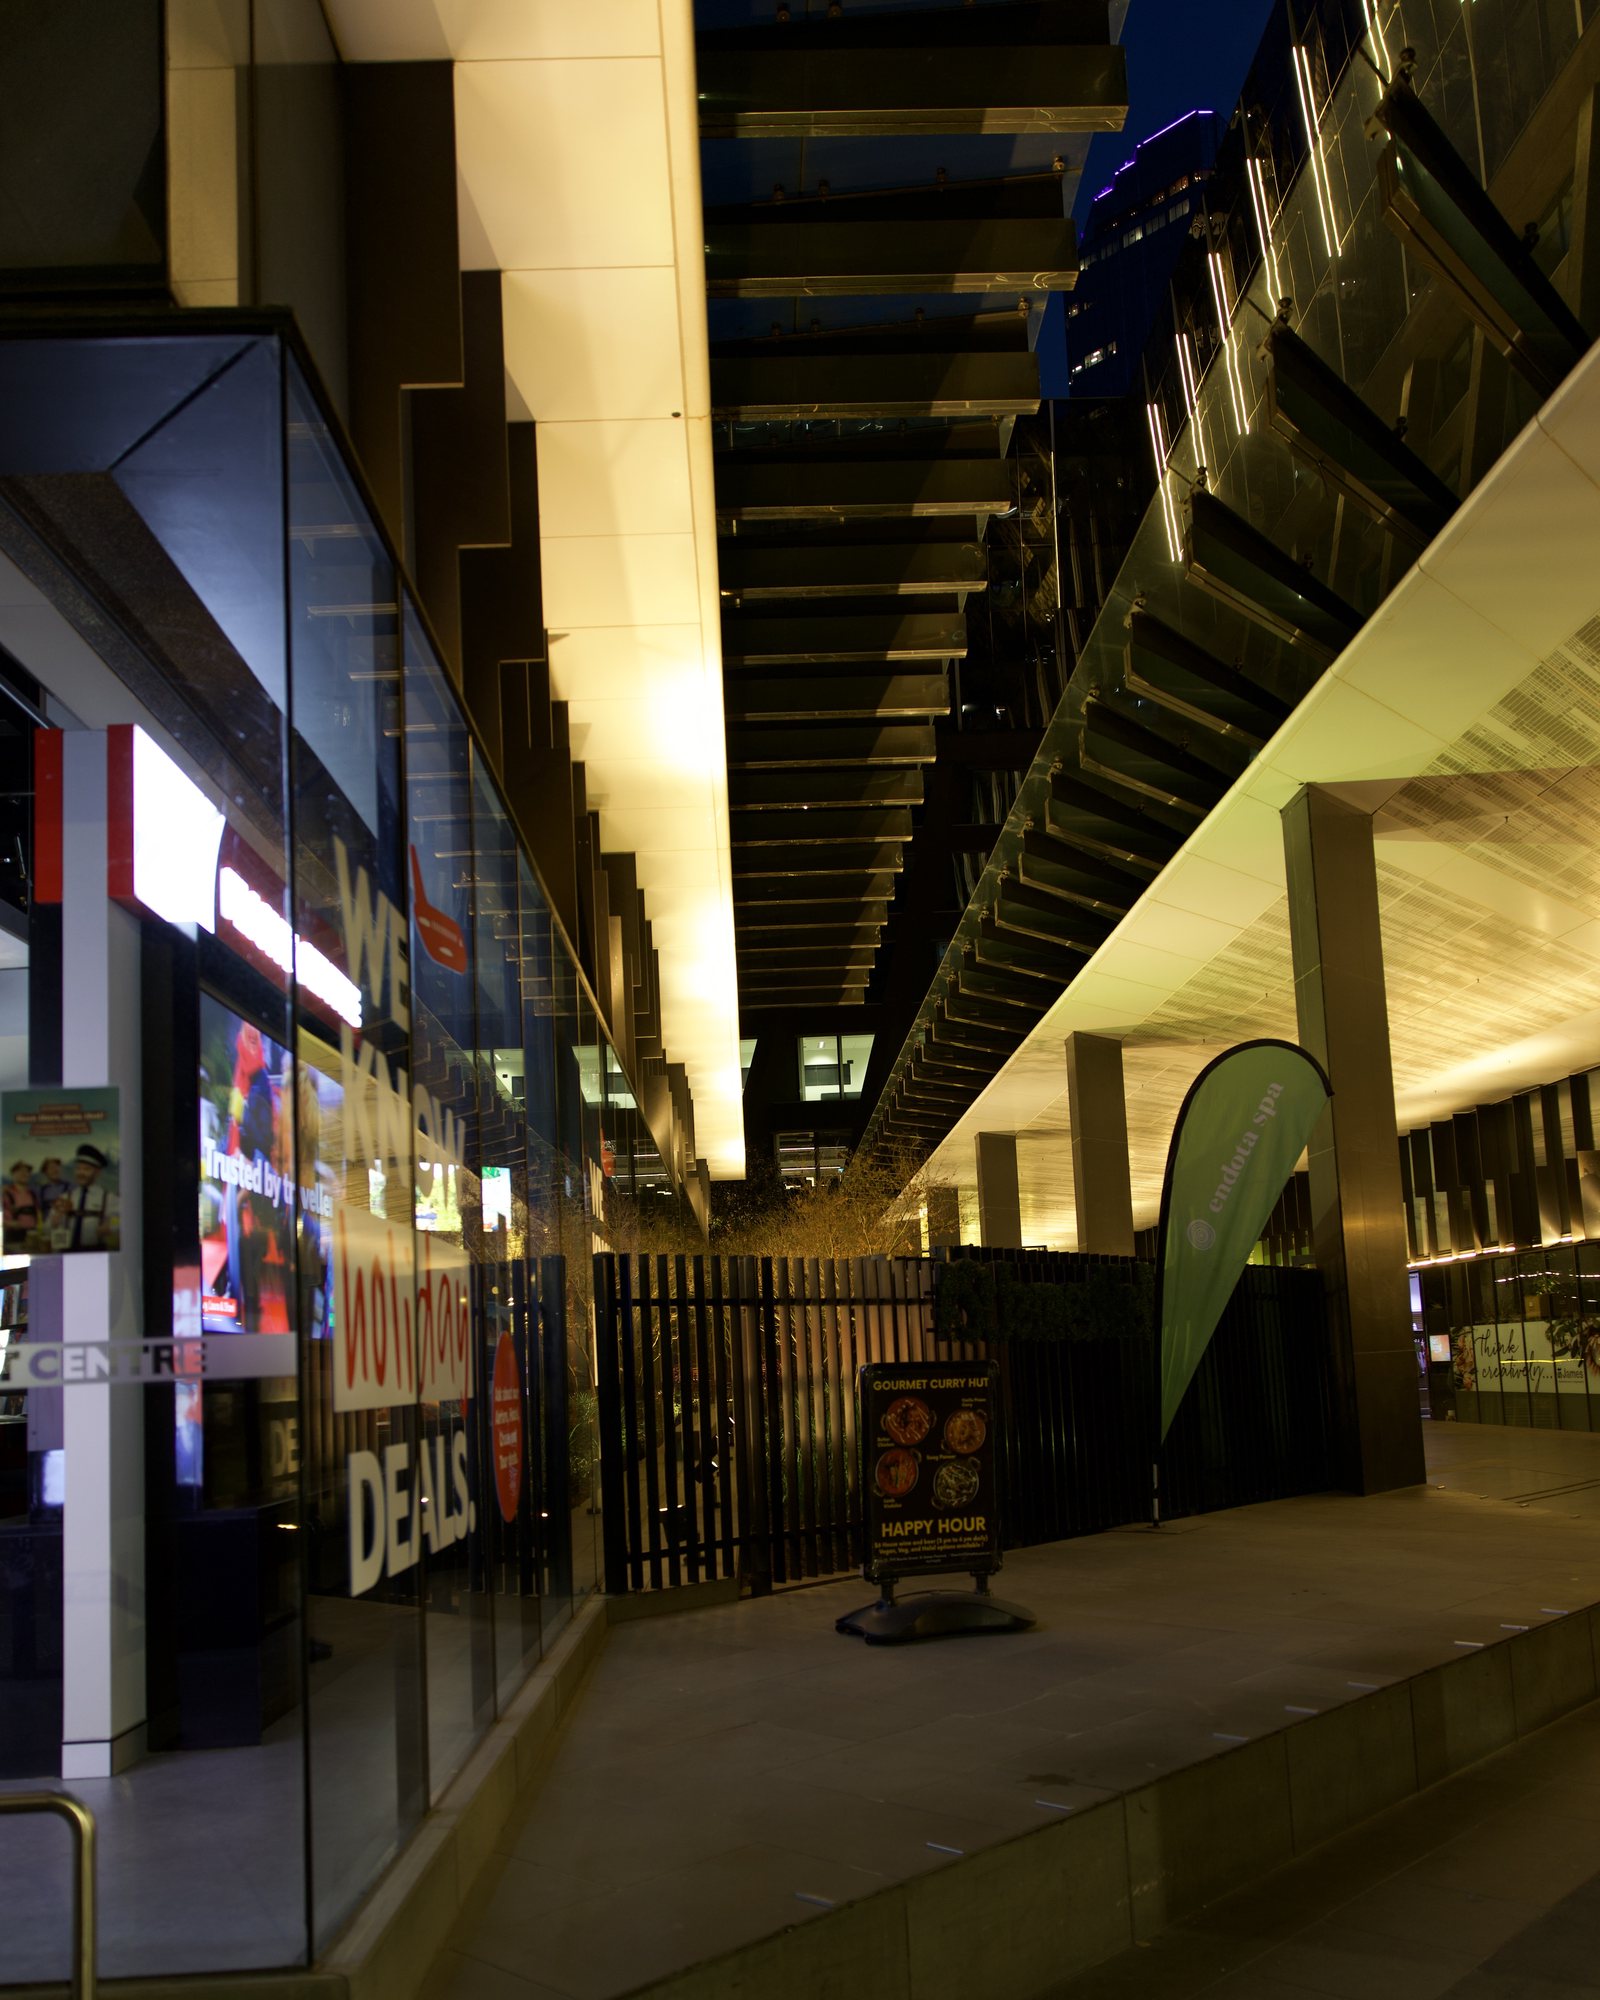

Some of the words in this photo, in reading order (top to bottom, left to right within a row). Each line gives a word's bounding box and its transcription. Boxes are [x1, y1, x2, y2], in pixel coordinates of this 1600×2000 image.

[334, 834, 409, 1032] WE
[340, 1021, 466, 1210] KNOW
[1208, 1130, 1260, 1213] endota
[1252, 1081, 1284, 1127] spa
[203, 1136, 262, 1194] Trusted
[264, 1161, 282, 1208] by
[28, 1341, 207, 1382] CENTRE
[339, 1208, 471, 1418] holiday
[1474, 1328, 1520, 1358] Think
[873, 1379, 928, 1391] GOURMET
[930, 1378, 966, 1390] CURRY
[967, 1377, 990, 1388] HUT
[348, 1428, 477, 1598] DEALS.
[881, 1519, 934, 1538] HAPPY
[938, 1516, 986, 1534] HOUR
